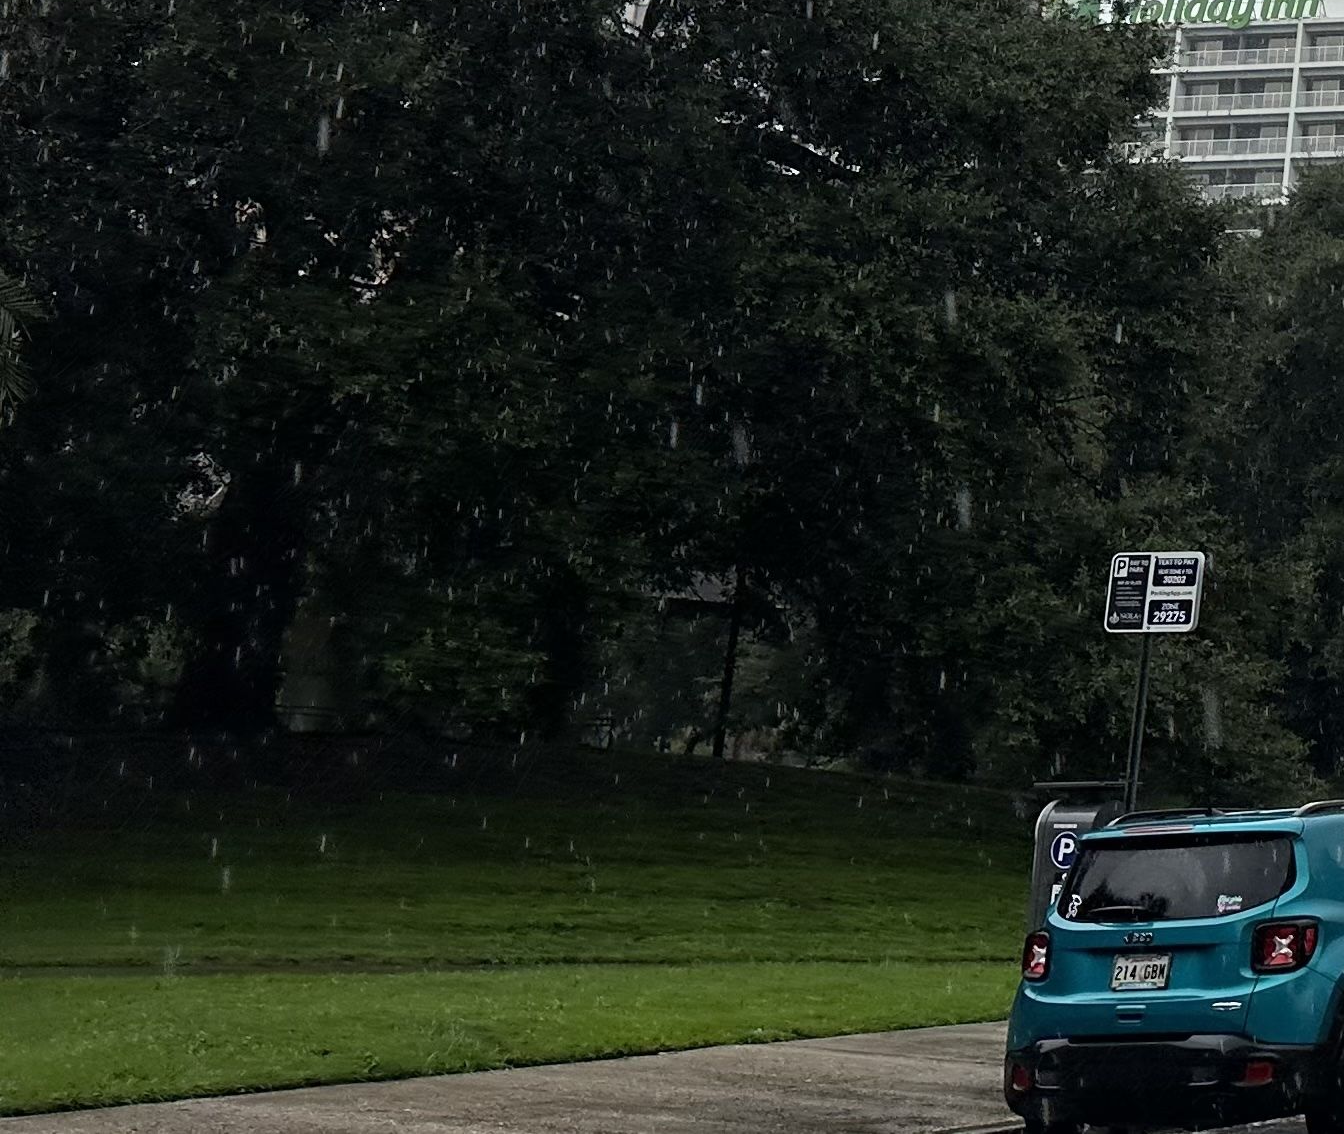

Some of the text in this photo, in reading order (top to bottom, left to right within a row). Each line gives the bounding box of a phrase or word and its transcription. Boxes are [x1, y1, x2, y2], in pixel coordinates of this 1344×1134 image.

[1152, 611, 1187, 623] 29275
[1057, 837, 1076, 862] P
[1114, 965, 1137, 981] 214
